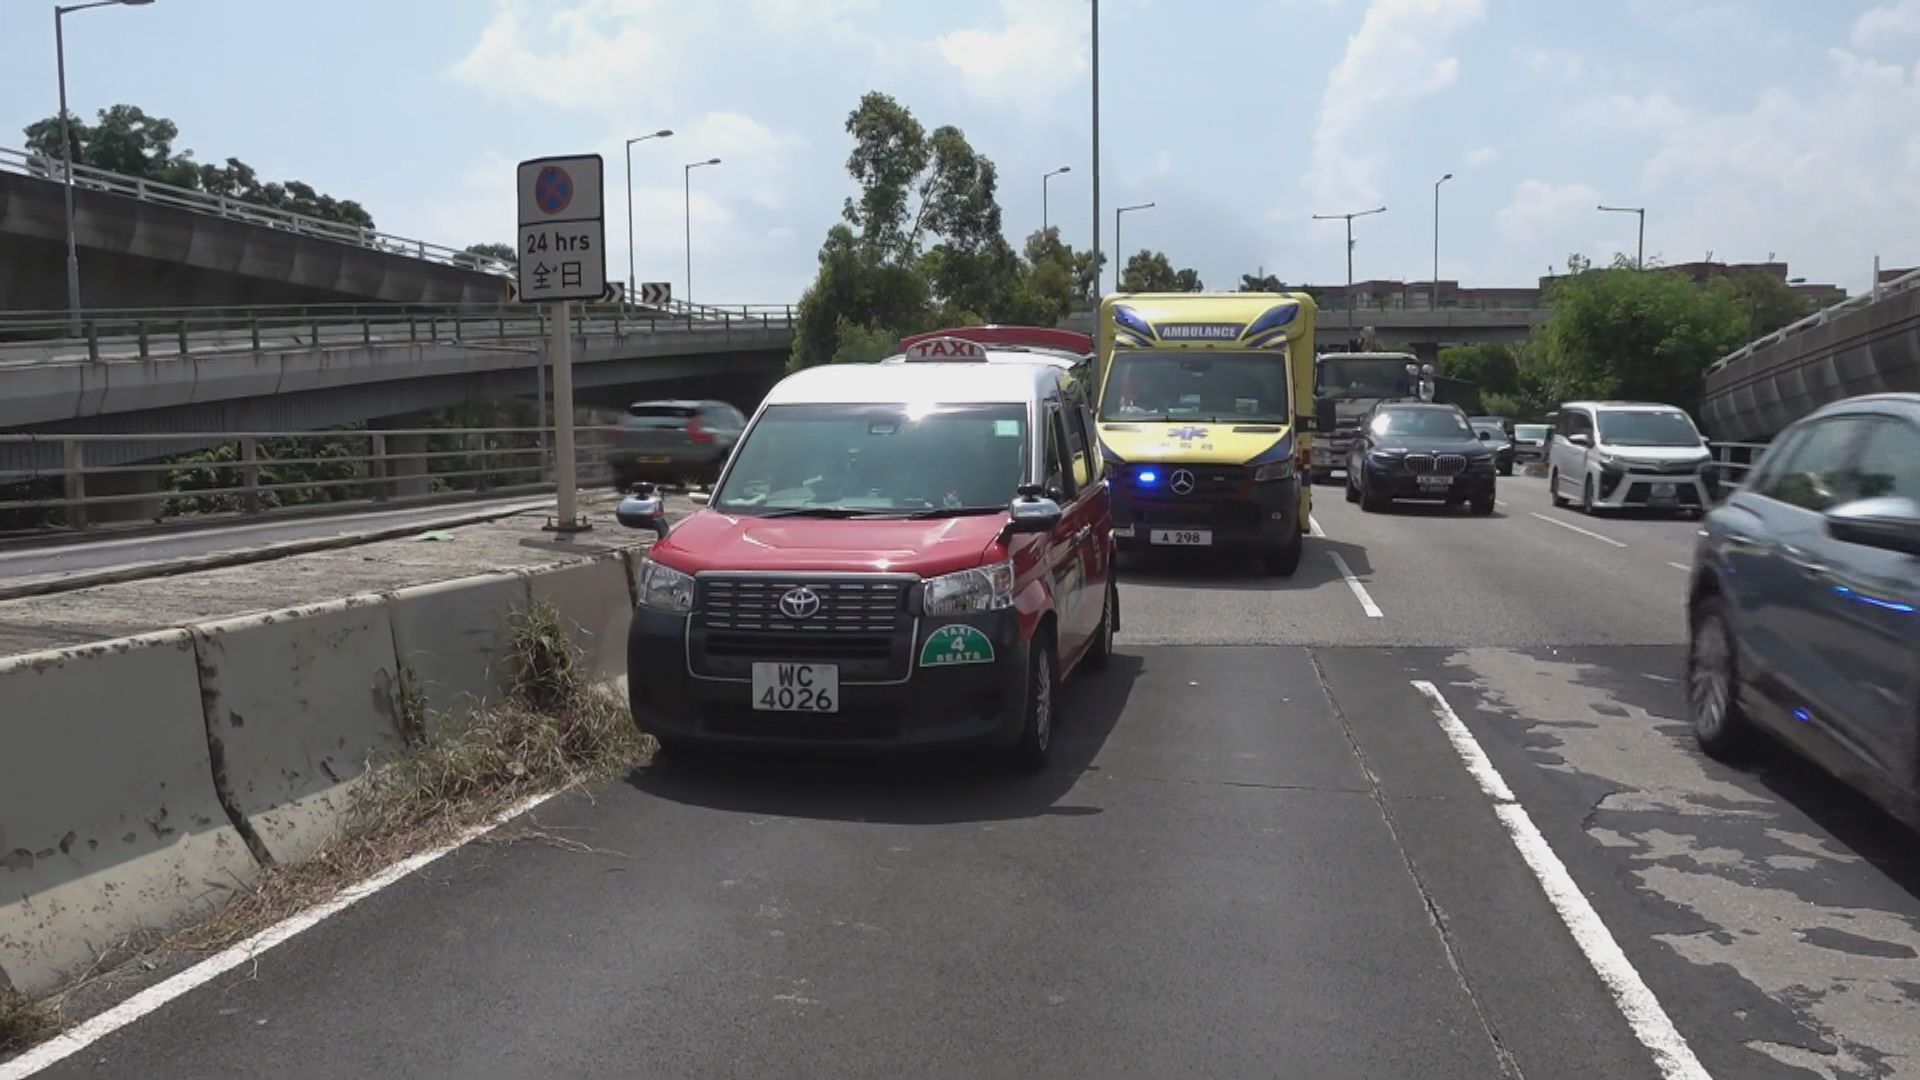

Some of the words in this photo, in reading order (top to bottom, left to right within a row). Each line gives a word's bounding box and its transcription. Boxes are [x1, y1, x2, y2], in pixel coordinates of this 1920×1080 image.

[527, 232, 548, 254] 24
[555, 232, 590, 252] hrs
[533, 261, 582, 289] 全日
[1162, 325, 1237, 338] AMBULANCE
[917, 341, 976, 357] TAXI
[1162, 532, 1169, 542] A
[1175, 532, 1201, 544] 298
[941, 626, 972, 637] TAXI
[951, 636, 966, 652] 4
[936, 651, 981, 663] SEATS
[778, 664, 813, 687] WC
[760, 686, 832, 710] 4026
